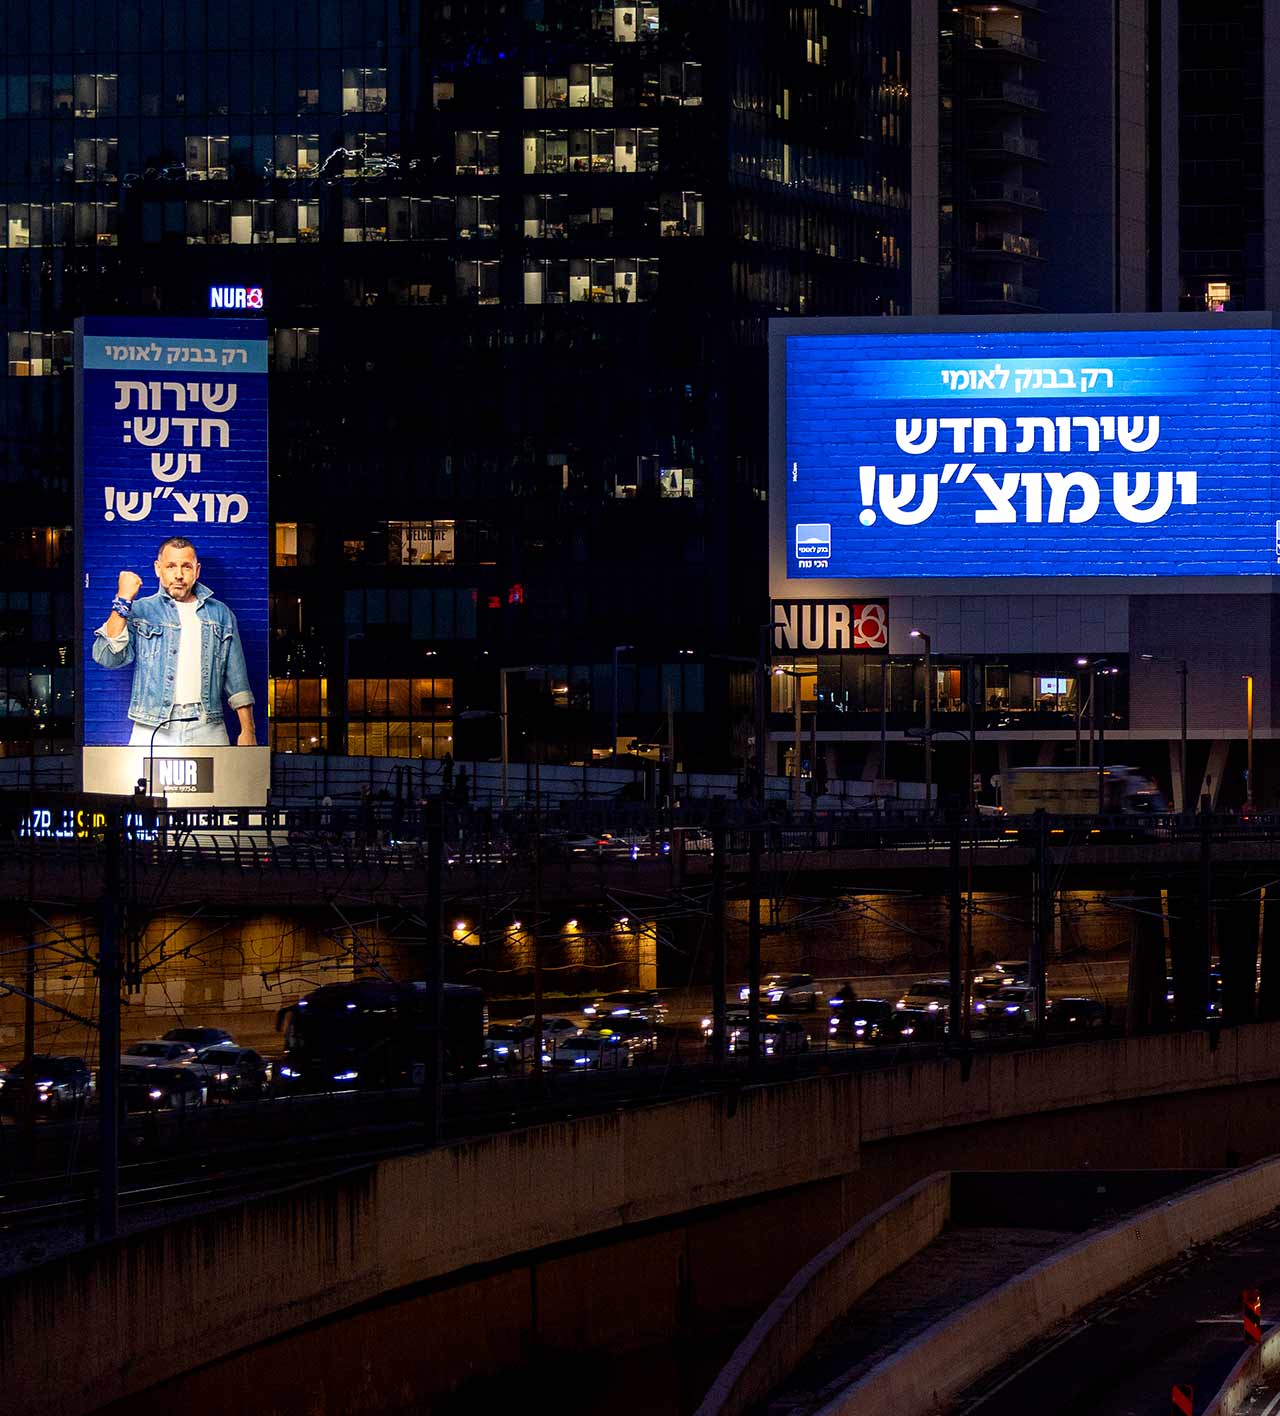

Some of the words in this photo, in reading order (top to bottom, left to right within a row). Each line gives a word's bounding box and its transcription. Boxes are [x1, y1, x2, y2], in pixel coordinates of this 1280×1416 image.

[211, 287, 247, 309] NUR
[105, 343, 163, 362] לאומי
[167, 346, 218, 365] בבנק
[222, 345, 248, 364] רק
[942, 364, 1008, 391] לאומי
[1014, 369, 1076, 394] בבנק
[1080, 369, 1113, 392] רק
[115, 381, 237, 412] שירות
[124, 417, 230, 447] חדש:
[896, 416, 1007, 454] חדש
[1016, 416, 1160, 454] שירות
[152, 453, 201, 482] יש
[1113, 470, 1198, 523] יש
[774, 603, 852, 650] NUR
[159, 759, 198, 785] NUR
